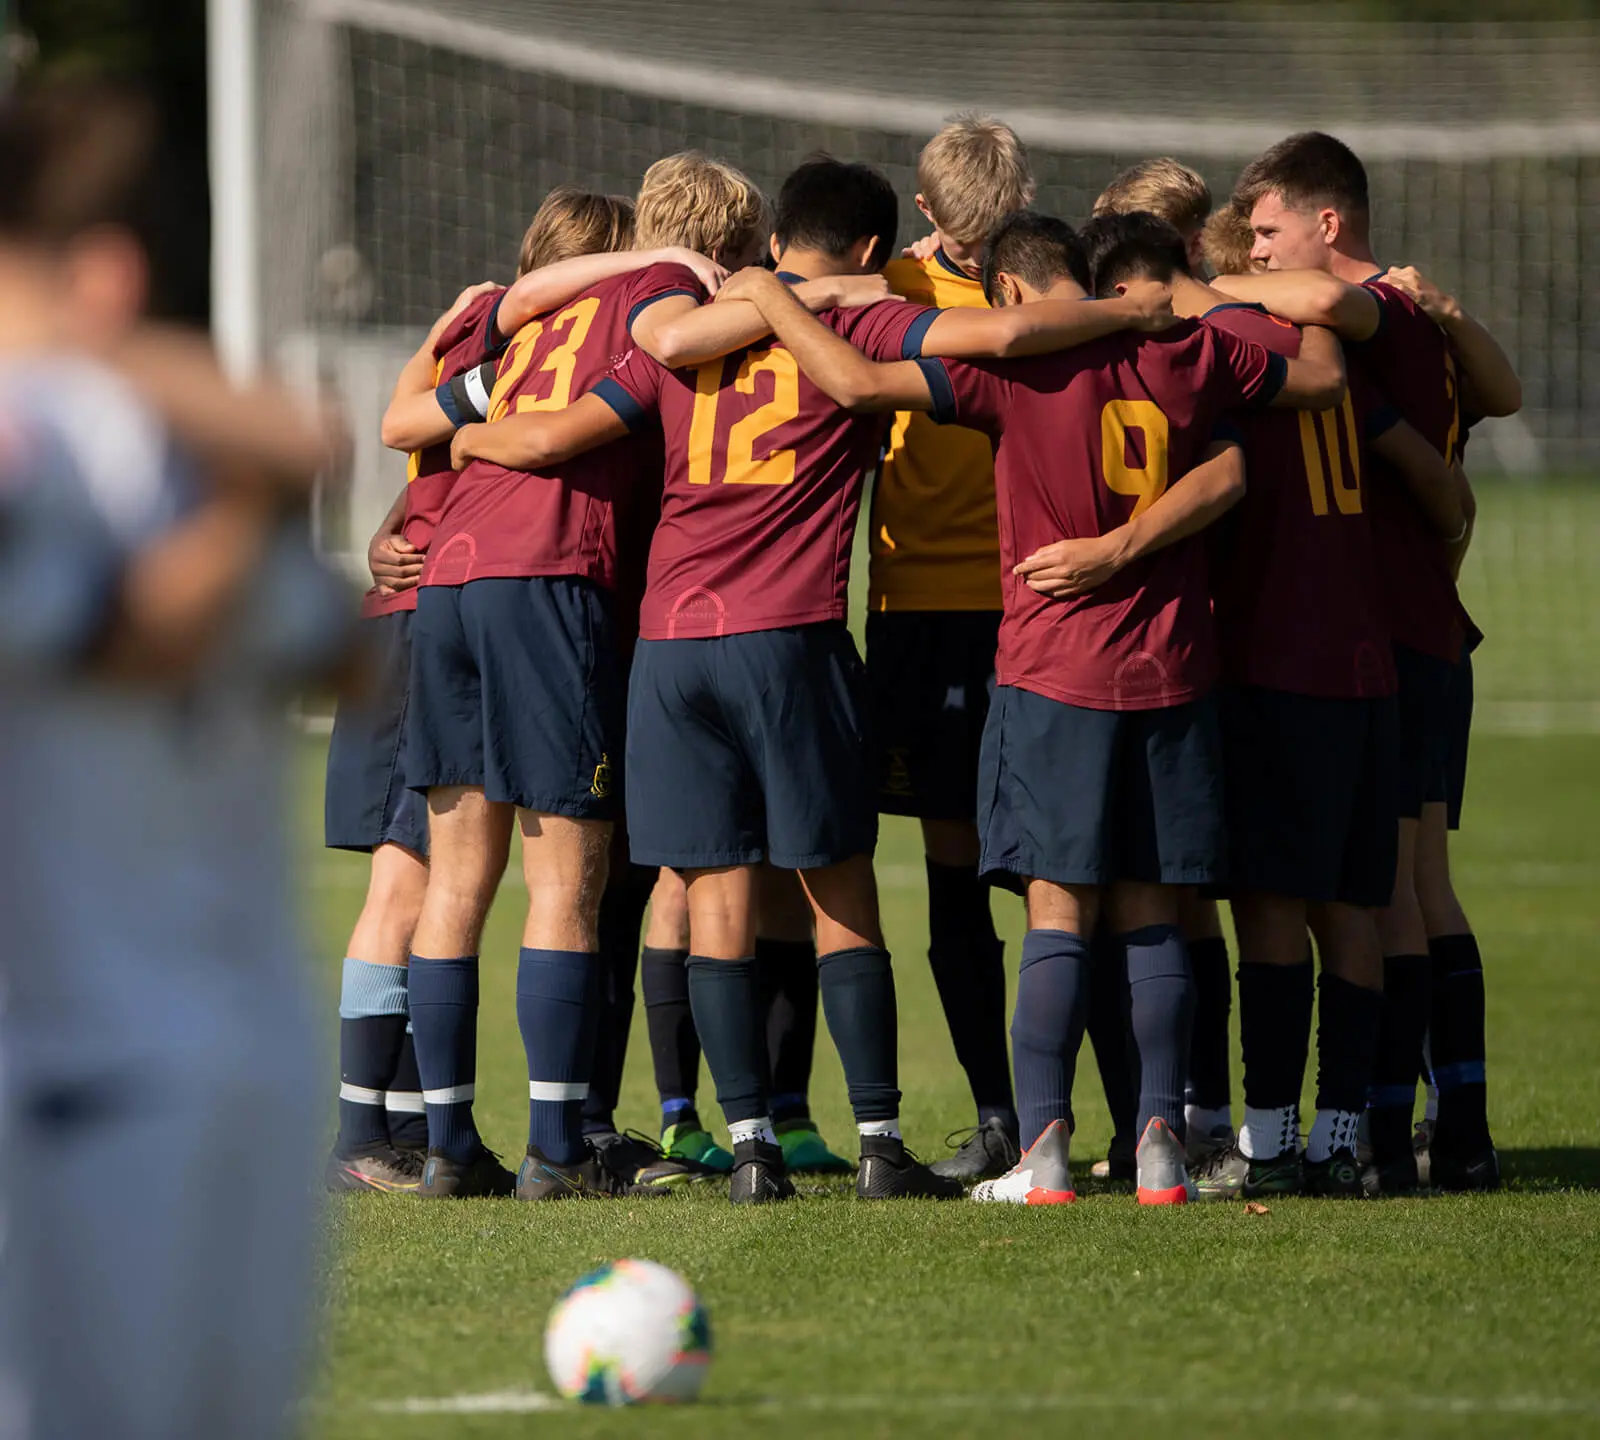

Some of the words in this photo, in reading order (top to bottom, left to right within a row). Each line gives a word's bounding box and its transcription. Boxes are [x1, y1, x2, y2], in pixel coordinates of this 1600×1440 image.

[486, 297, 600, 424] 23
[687, 348, 799, 484] 12
[1101, 399, 1168, 523] 9
[1298, 385, 1363, 516] 10
